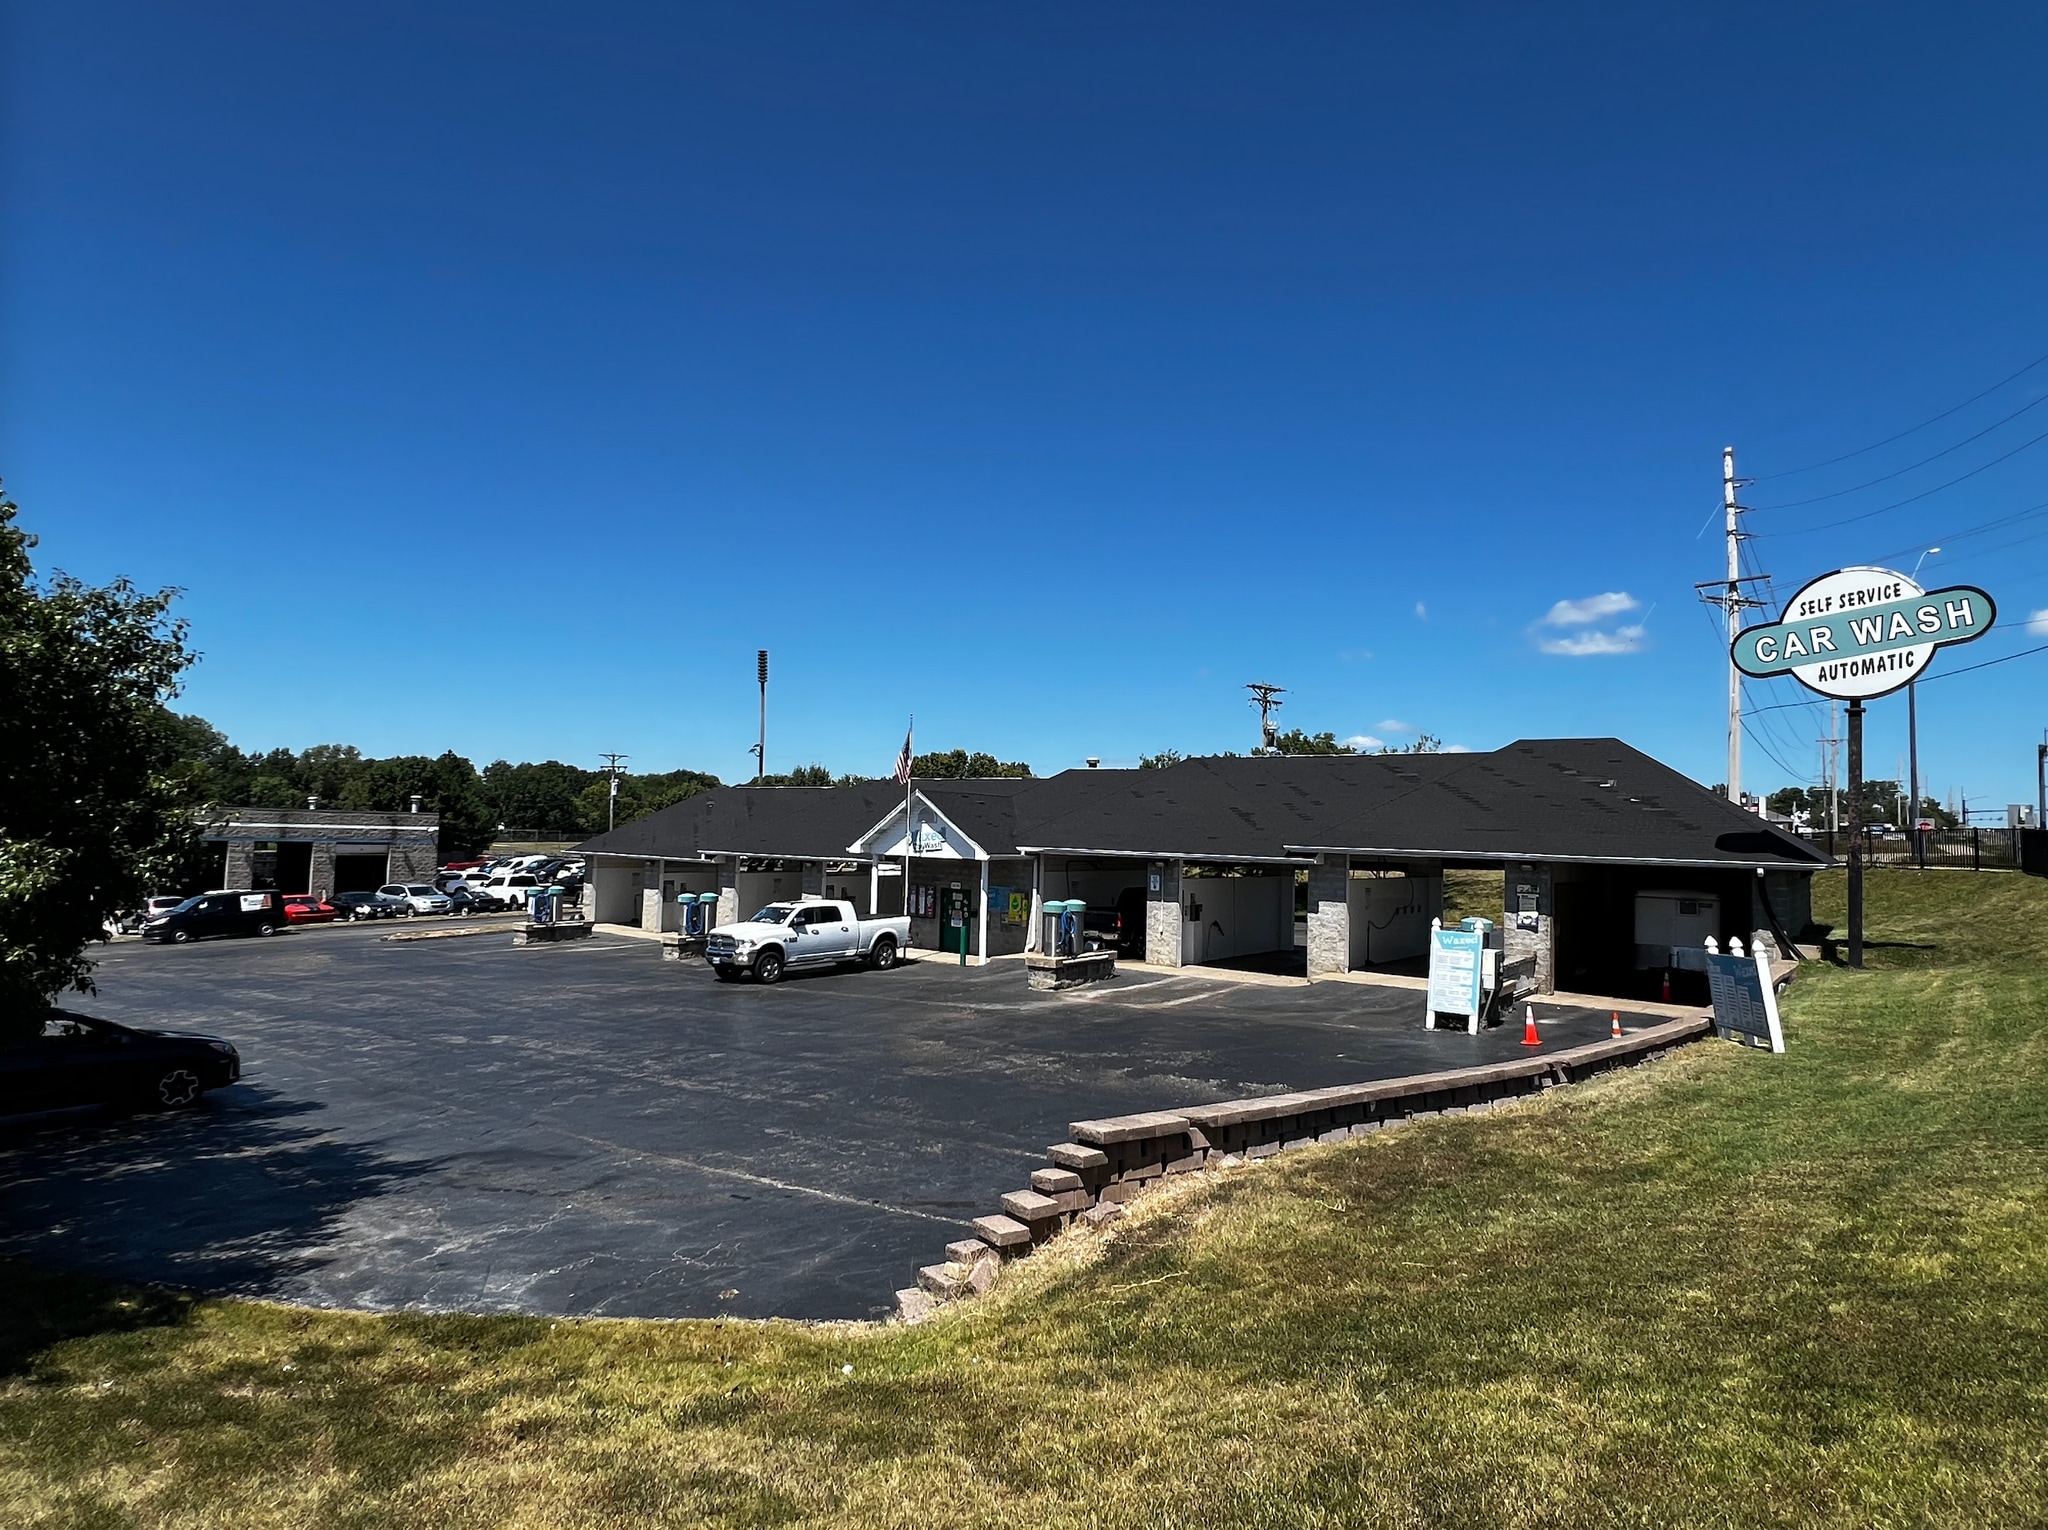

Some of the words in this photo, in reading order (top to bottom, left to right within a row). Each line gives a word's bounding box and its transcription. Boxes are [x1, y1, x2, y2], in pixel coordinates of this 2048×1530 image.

[1799, 596, 1832, 616] SELF
[1839, 583, 1902, 609] SERVICE
[1754, 626, 1837, 663] CAR
[1848, 598, 1975, 646] WASH
[1818, 651, 1915, 683] AUTOMATIC
[1441, 935, 1478, 945] Waxed
